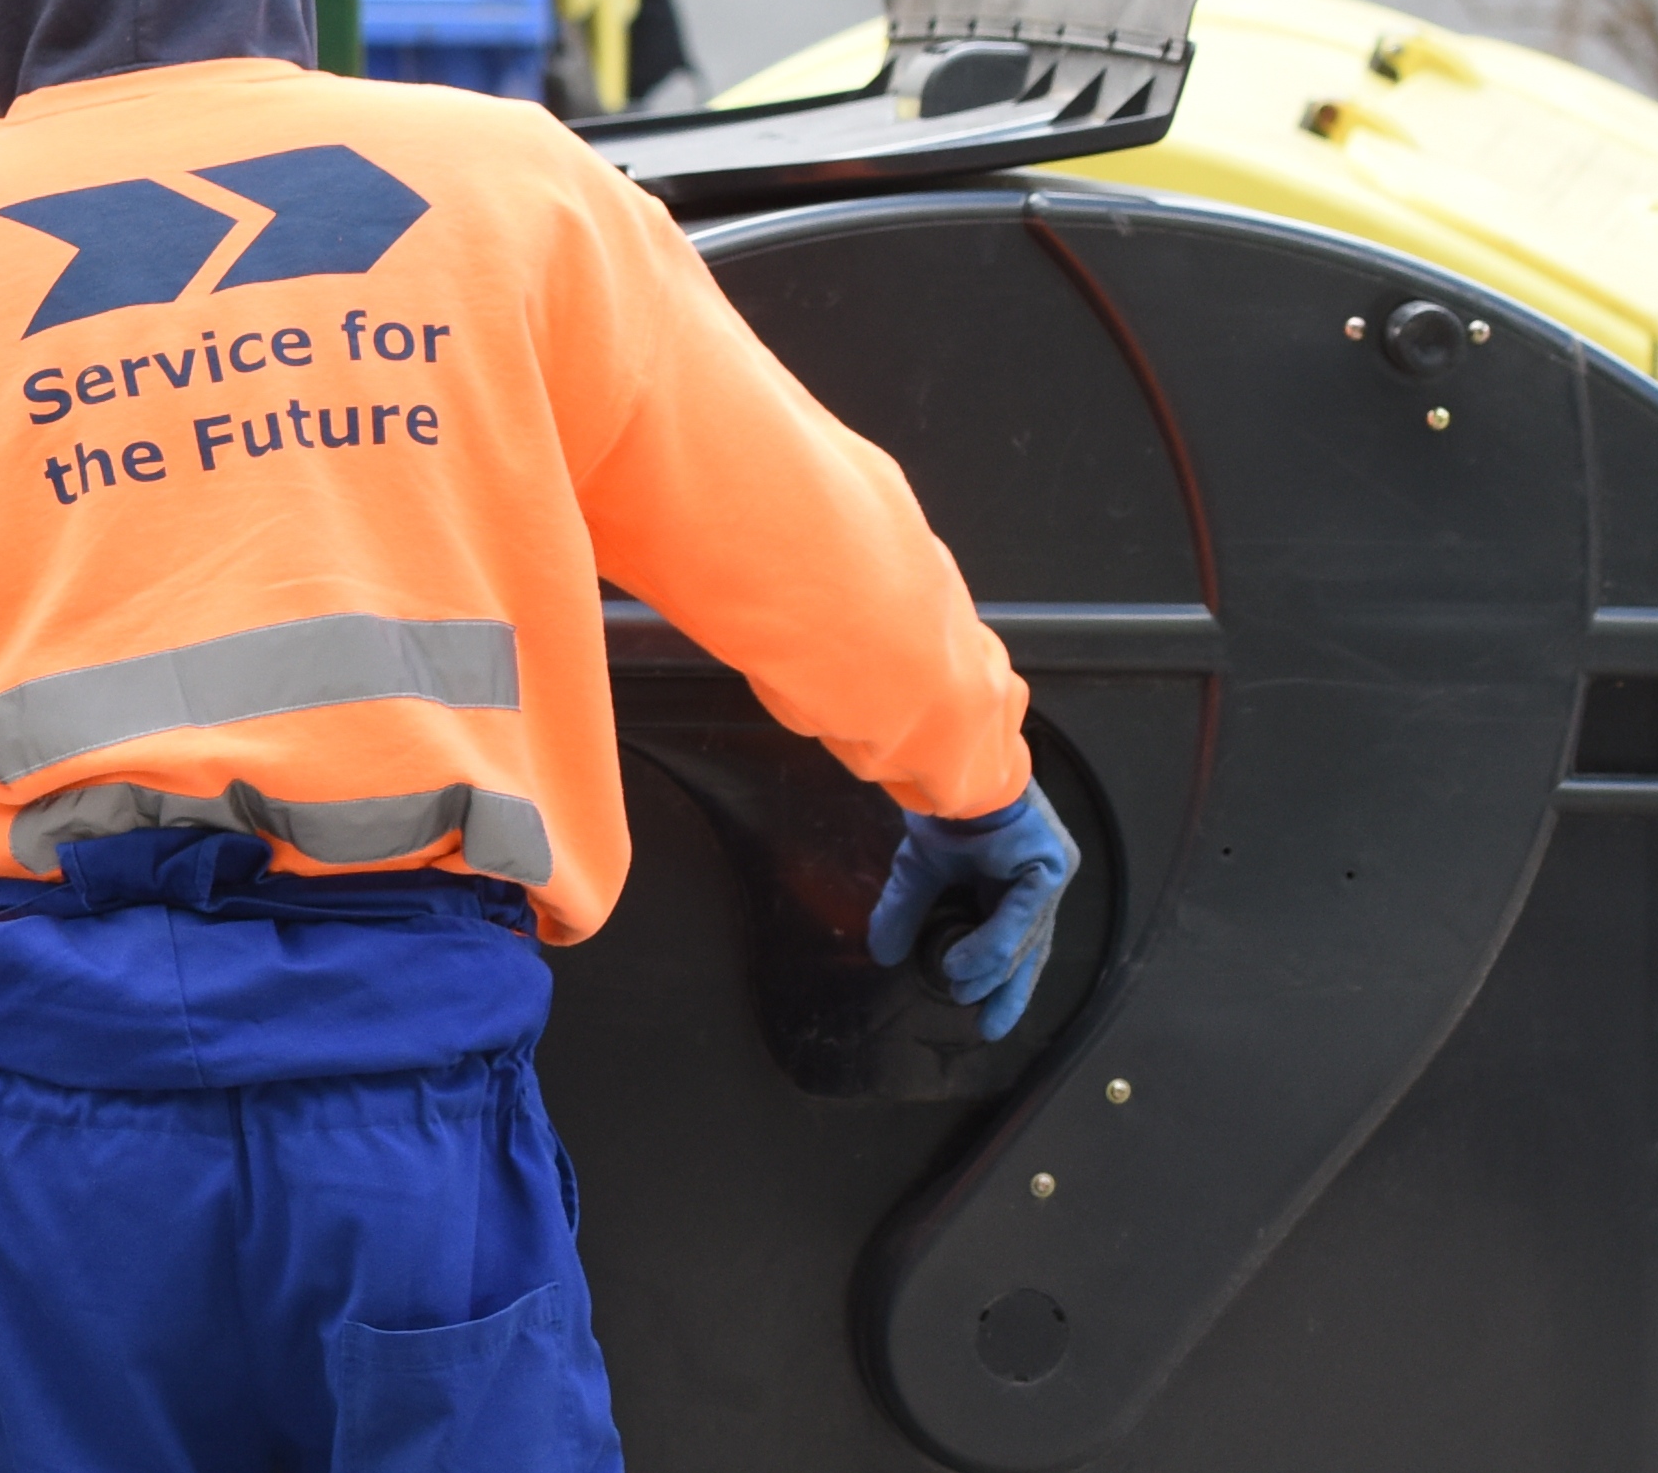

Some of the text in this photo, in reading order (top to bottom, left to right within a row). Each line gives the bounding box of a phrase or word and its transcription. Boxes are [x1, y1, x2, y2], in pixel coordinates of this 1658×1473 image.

[22, 310, 451, 425] Service for
[44, 399, 439, 505] the Future
